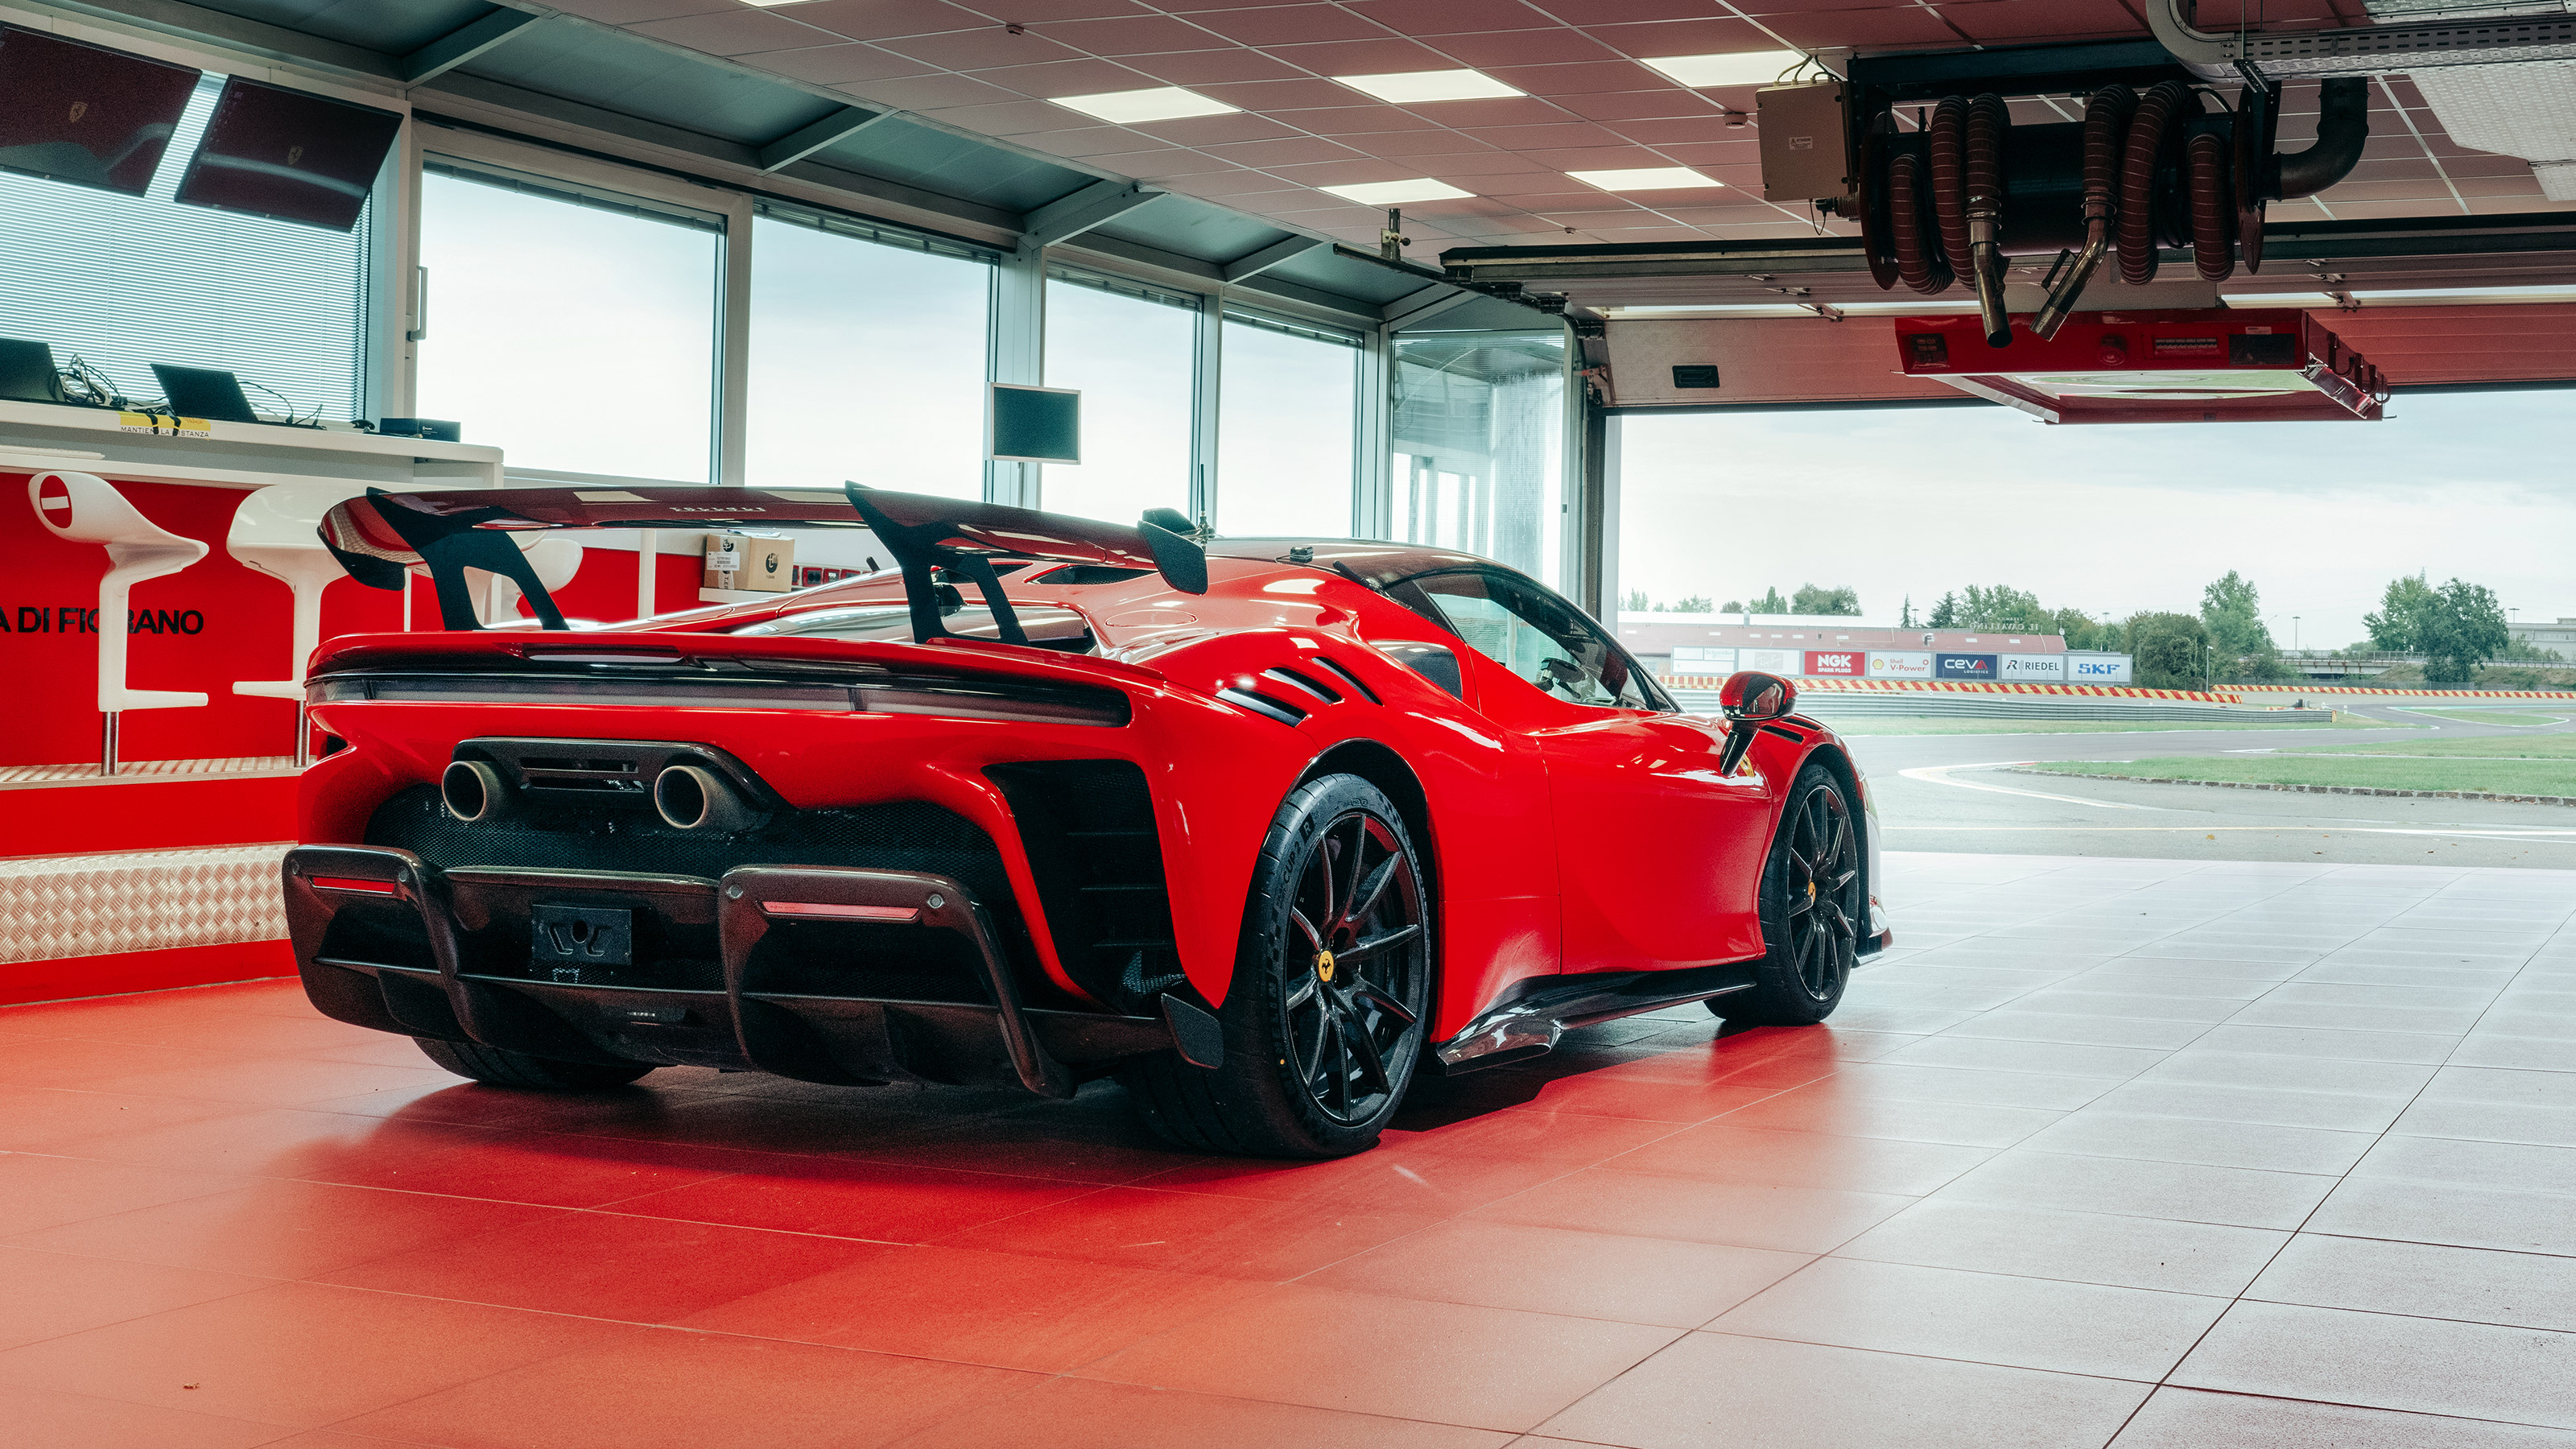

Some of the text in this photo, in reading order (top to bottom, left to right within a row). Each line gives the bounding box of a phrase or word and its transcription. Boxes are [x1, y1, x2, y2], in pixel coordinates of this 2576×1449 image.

[18, 607, 49, 633] DI
[1818, 654, 1852, 667] NGK
[2025, 662, 2059, 671] RIEDEL
[1890, 664, 1926, 672] V-Power
[2078, 663, 2120, 675] SKF
[1303, 821, 1311, 836] R
[1284, 851, 1295, 884] CUP
[1294, 840, 1302, 854] 2
